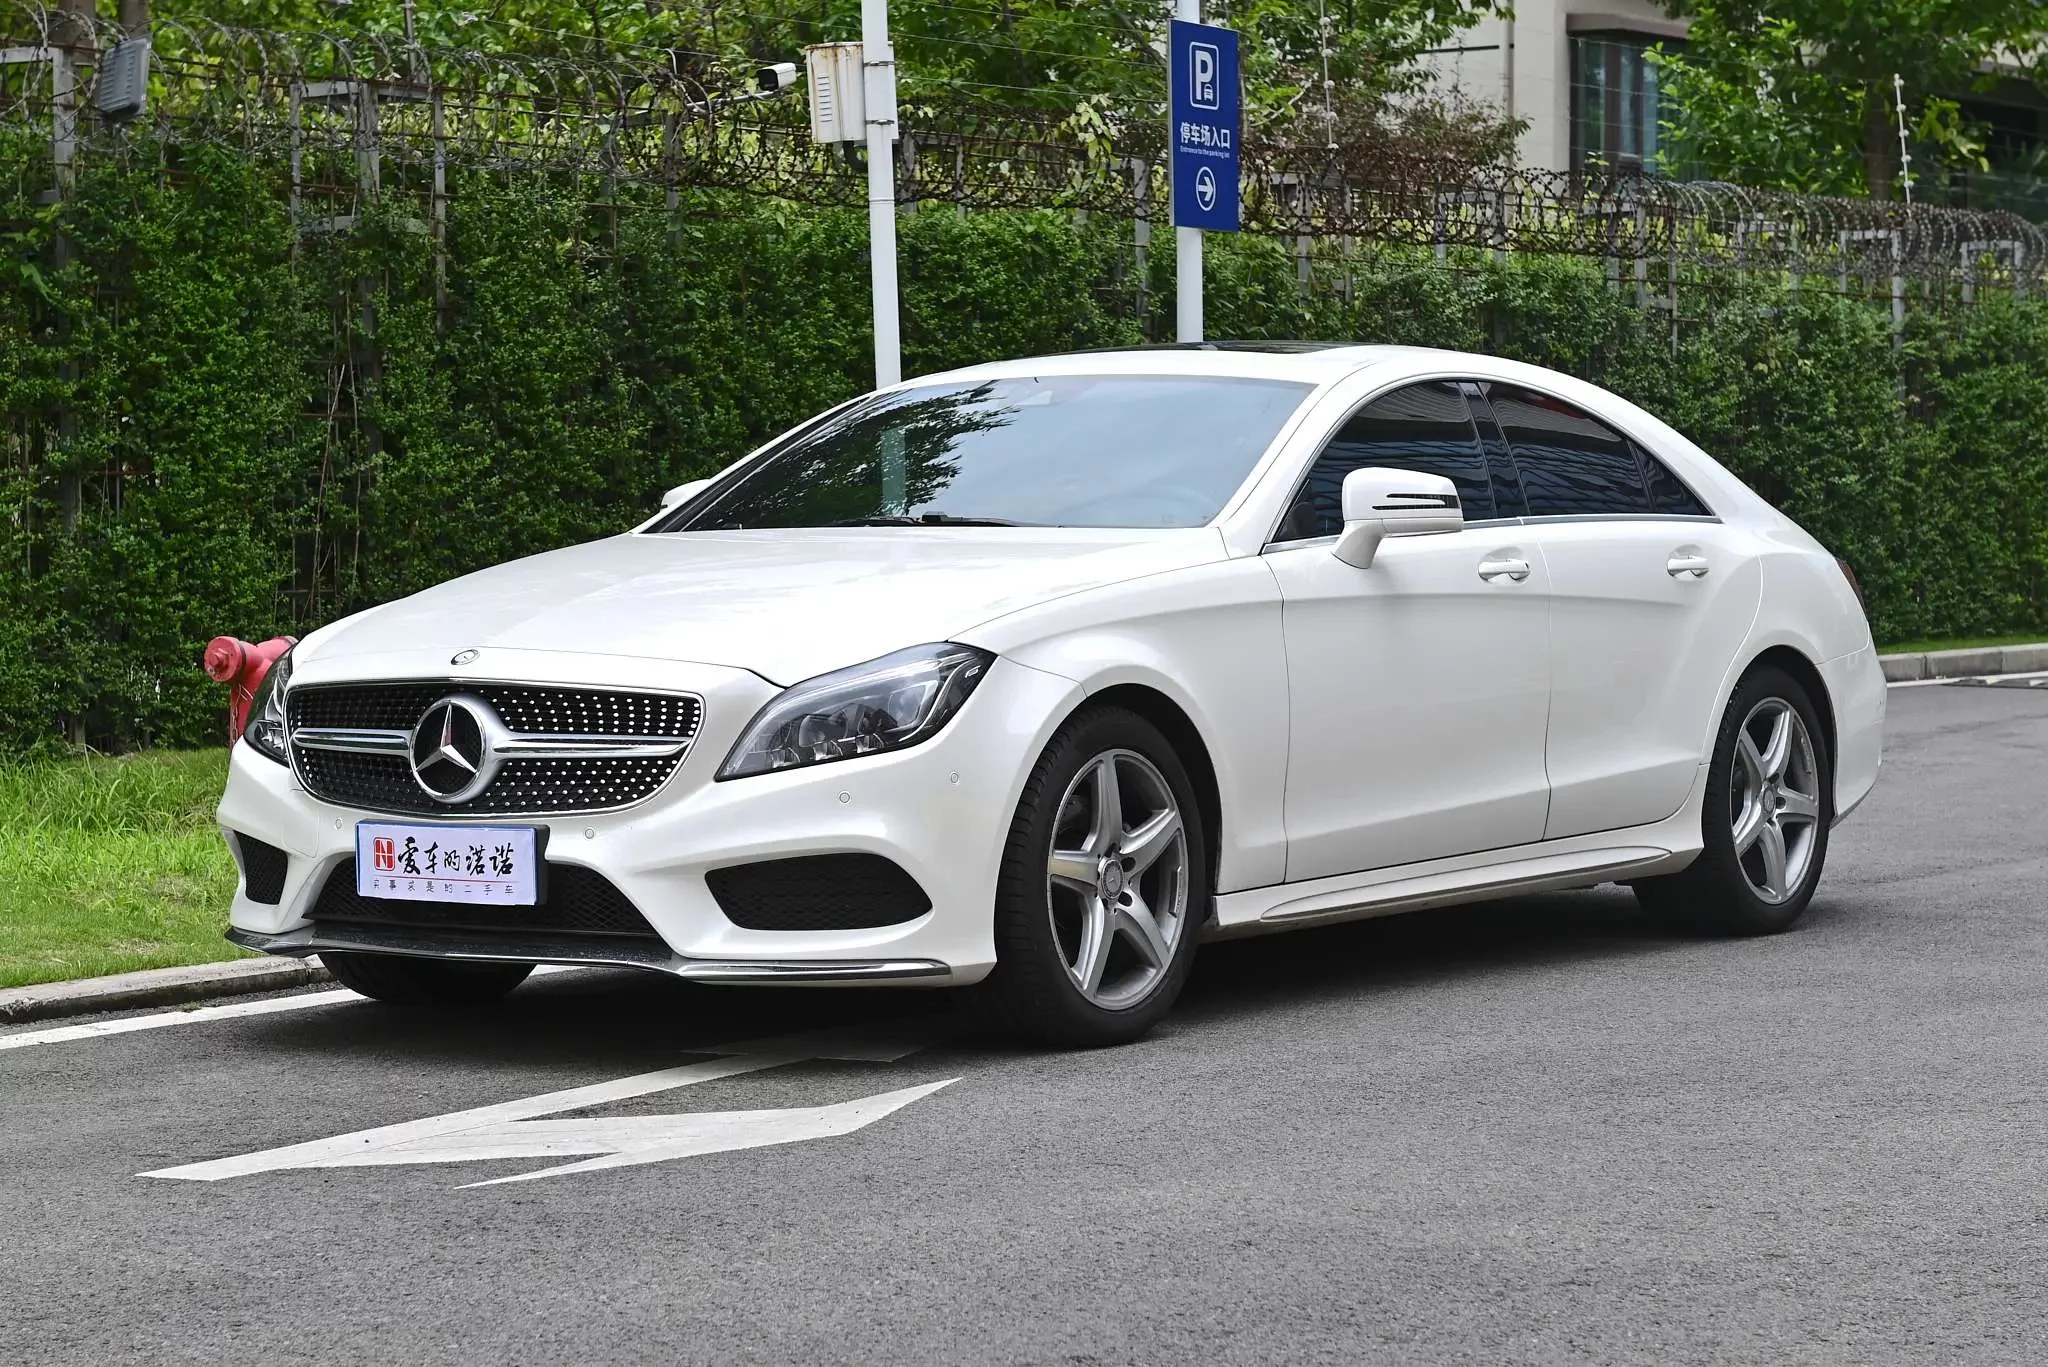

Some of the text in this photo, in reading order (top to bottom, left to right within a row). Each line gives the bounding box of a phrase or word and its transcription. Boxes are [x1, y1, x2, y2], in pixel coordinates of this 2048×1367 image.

[1195, 50, 1213, 100] P
[1180, 122, 1230, 149] 停车场入口
[1208, 150, 1224, 159] parking
